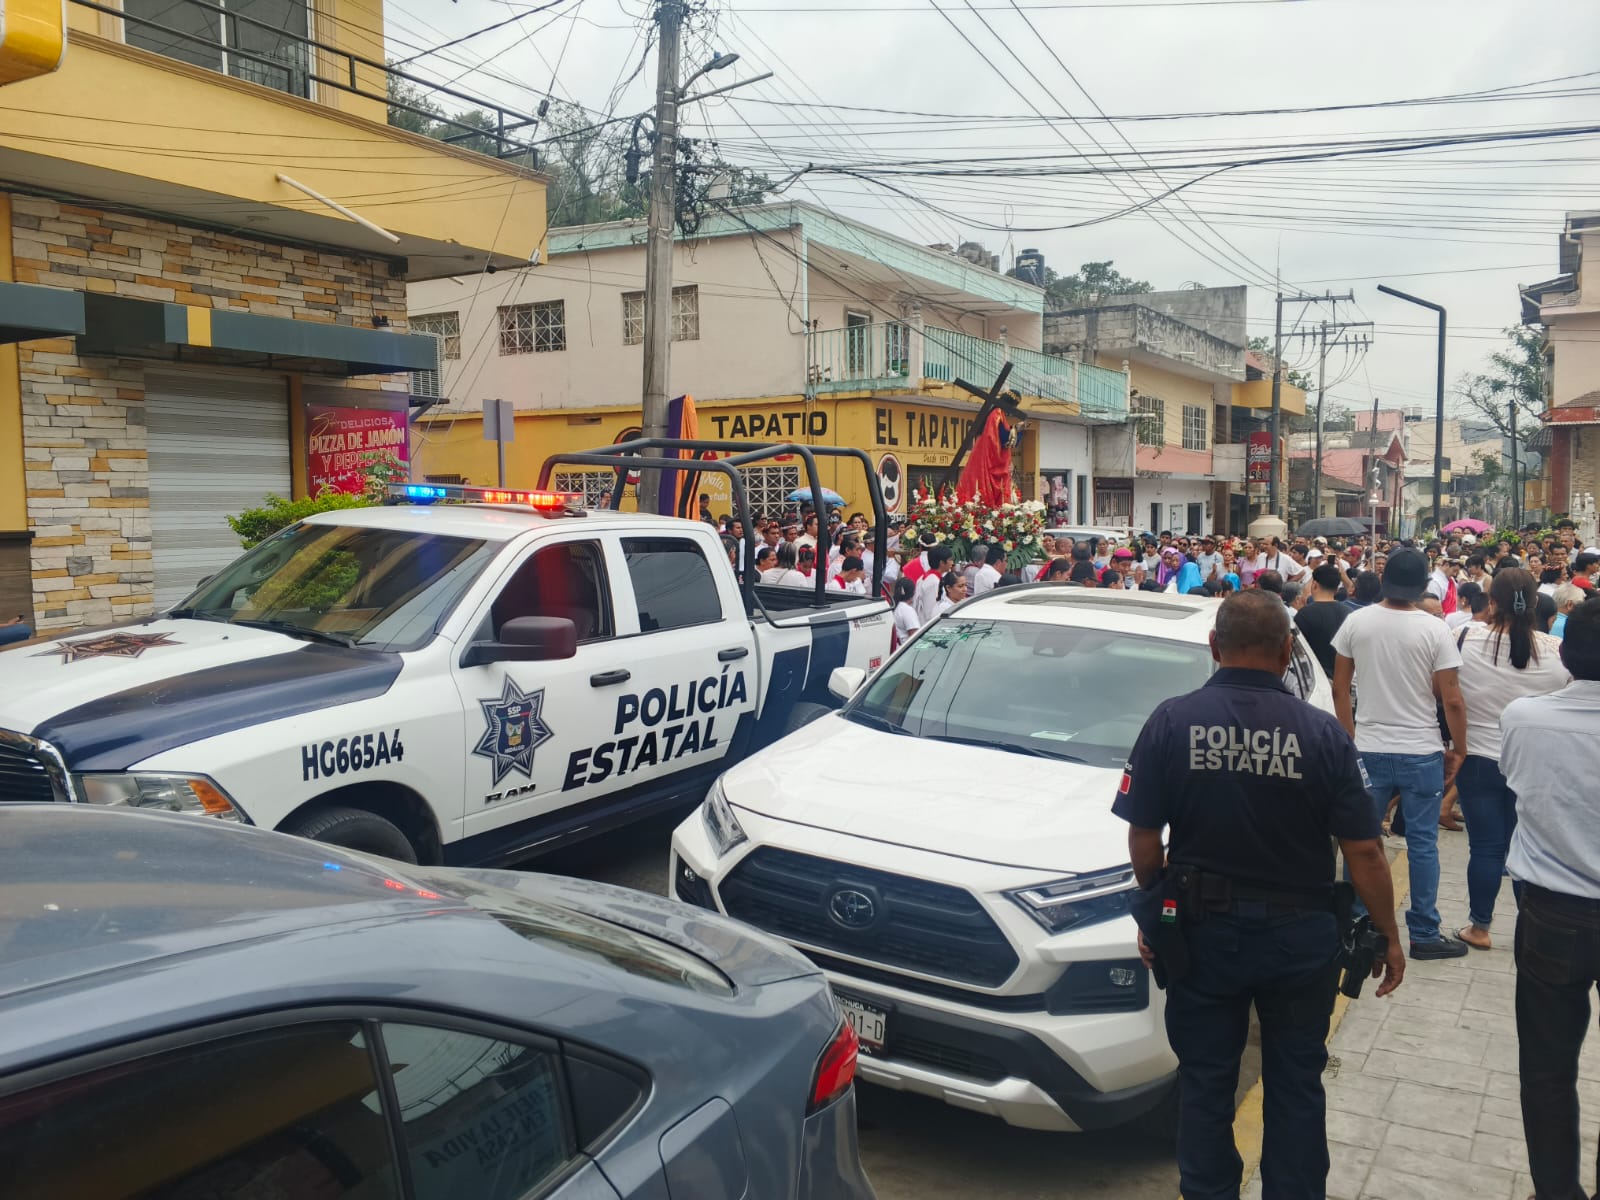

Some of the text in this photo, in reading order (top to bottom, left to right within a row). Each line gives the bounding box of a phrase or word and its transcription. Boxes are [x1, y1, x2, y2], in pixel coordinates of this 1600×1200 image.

[341, 417, 395, 429] DELICIOSA
[711, 411, 827, 439] TAPATIO
[876, 408, 898, 446] EL
[309, 424, 405, 454] PIZZA DE JAMÓN
[322, 455, 331, 473] Y
[507, 705, 521, 716] SSP
[614, 664, 747, 735] POLICÍA
[302, 729, 404, 781] HG665A4
[561, 716, 718, 792] ESTATAL
[1190, 725, 1302, 758] POLICÍA
[1190, 749, 1302, 779] ESTATAL
[485, 783, 536, 804] RAM
